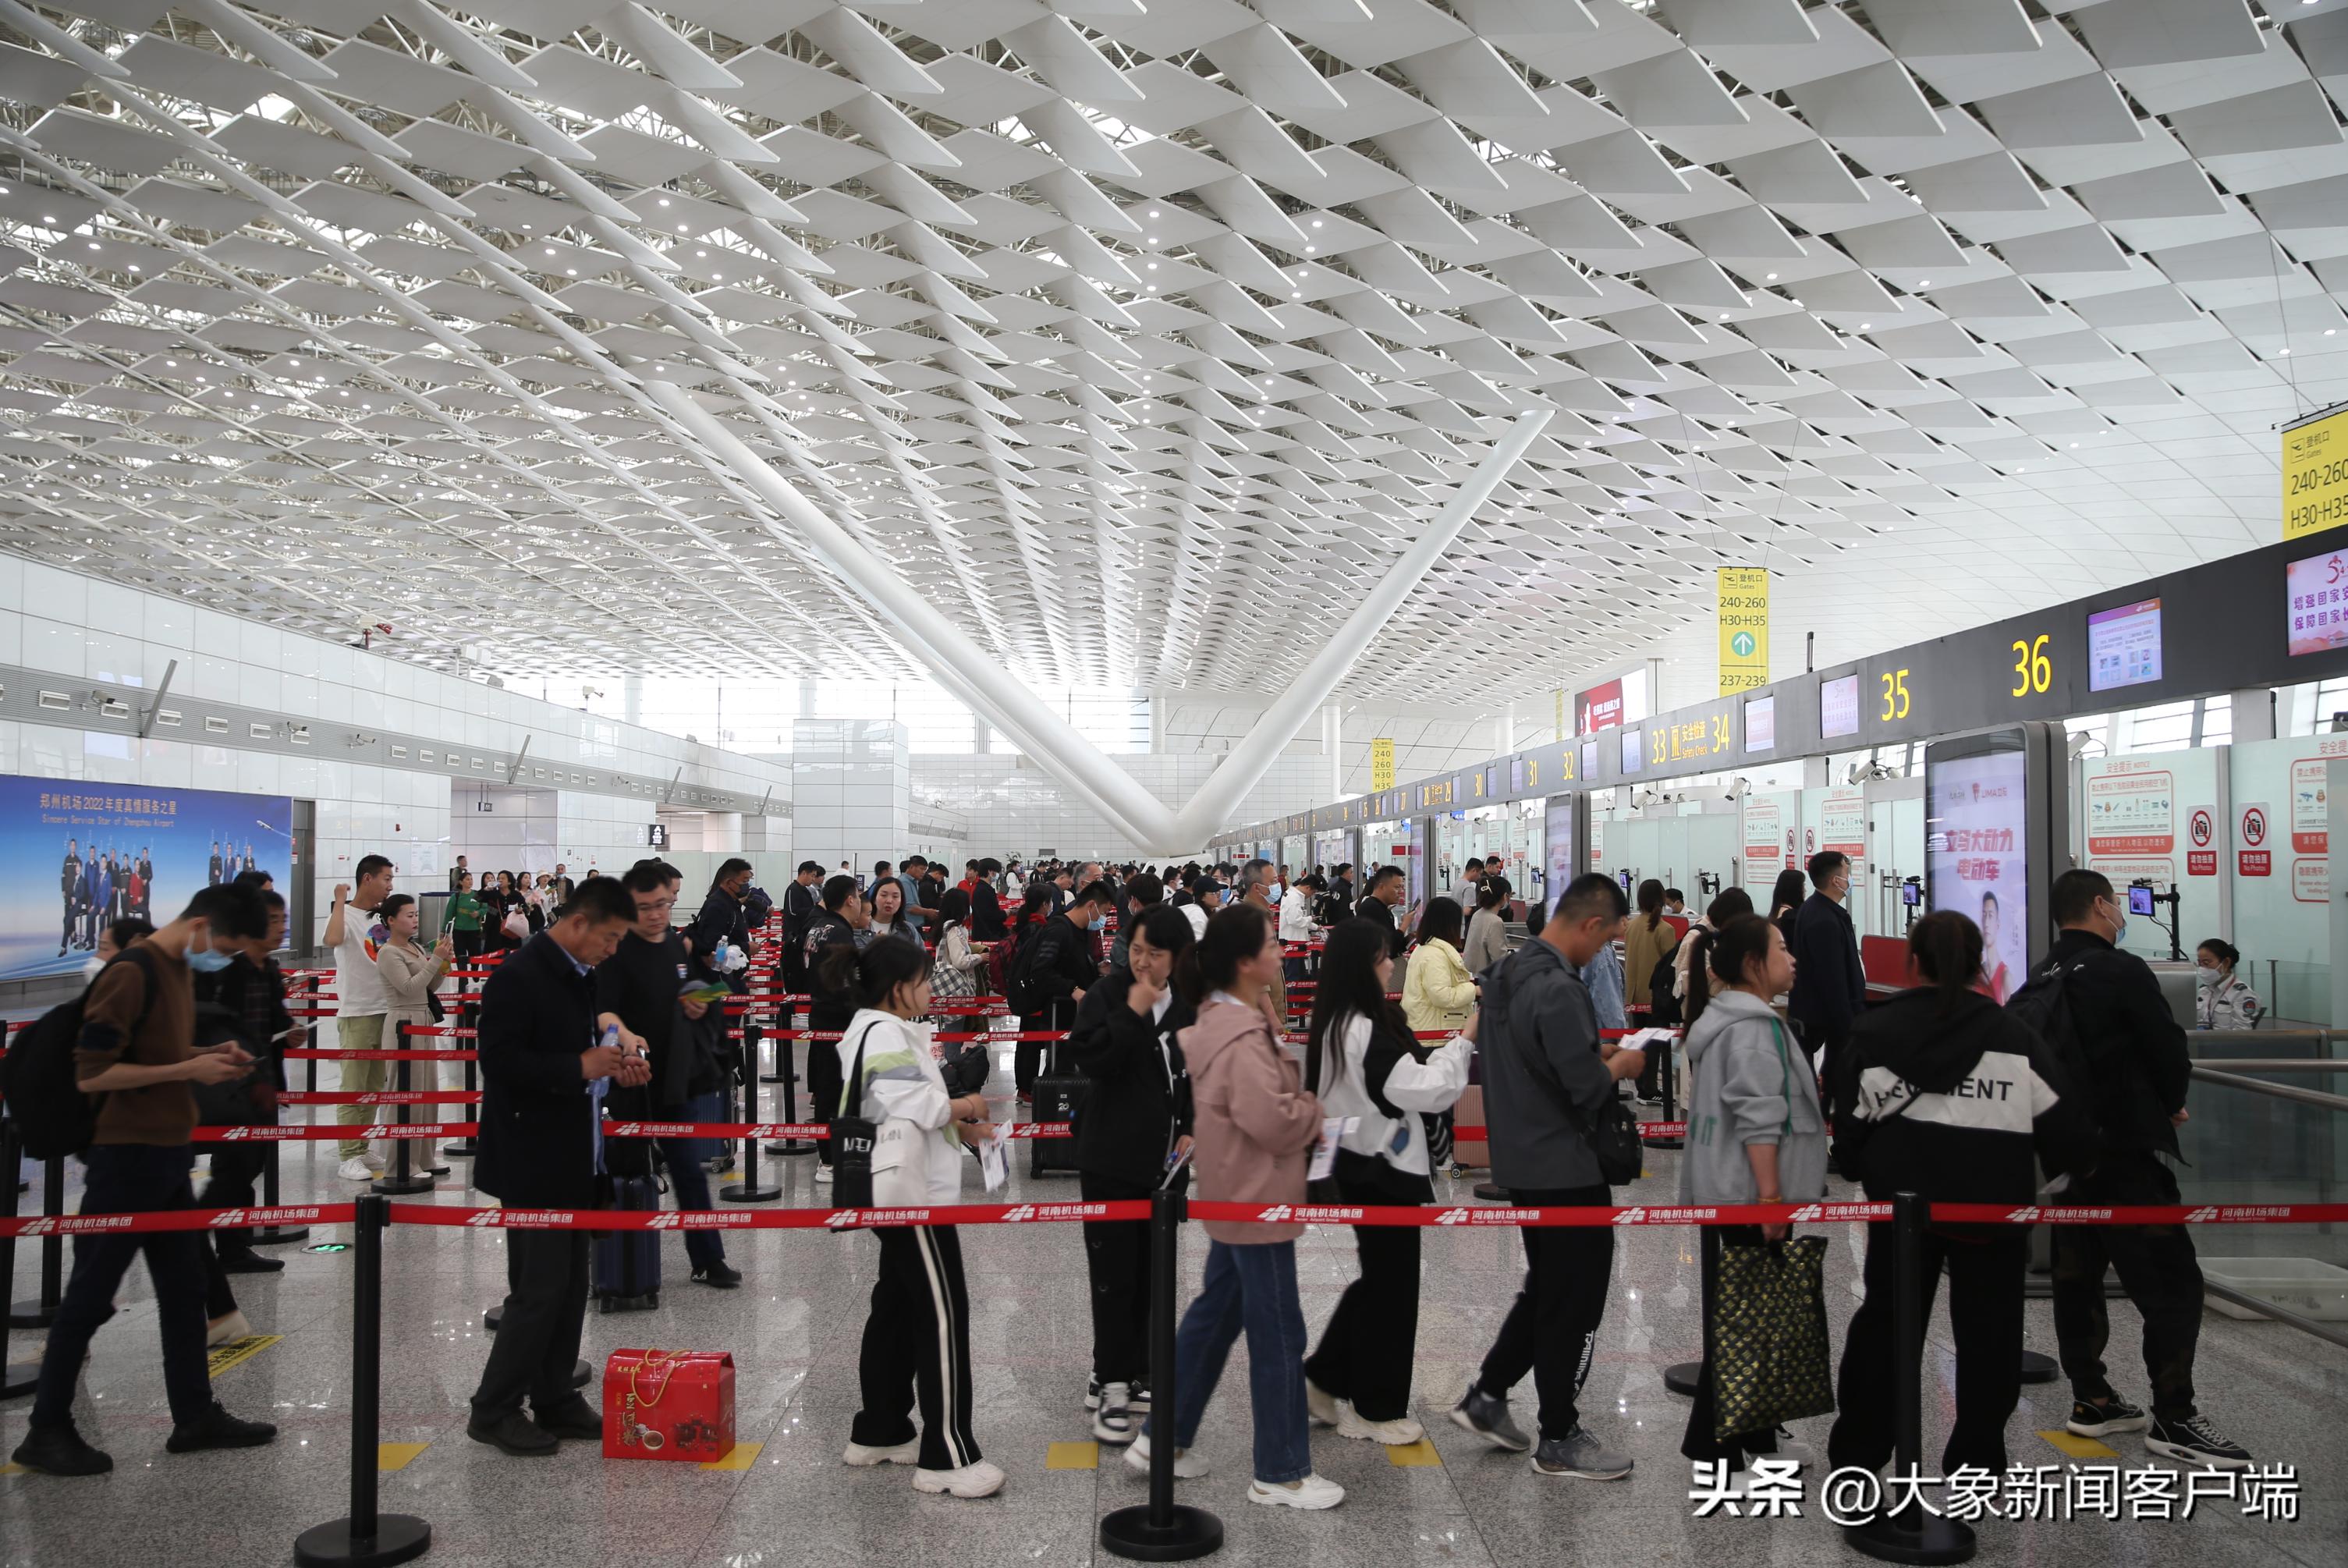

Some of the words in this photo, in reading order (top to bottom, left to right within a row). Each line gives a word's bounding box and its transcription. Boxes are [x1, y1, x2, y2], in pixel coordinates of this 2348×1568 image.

[2307, 431, 2330, 449] 登机口
[2307, 449, 2322, 459] Gates
[2013, 635, 2052, 697] 36
[1882, 669, 1910, 722] 35
[1682, 720, 1706, 742] 安全检查
[1712, 713, 1729, 753] 34
[1652, 729, 1666, 764] 33
[1563, 750, 1573, 780] 32
[1529, 760, 1538, 787] 31
[1475, 774, 1482, 796] 30
[1946, 828, 2013, 852] 立马大动力
[1957, 858, 2000, 881] 电动车
[251, 1127, 305, 1136] 河南机场集团
[390, 1126, 442, 1135] 河南机场集团
[775, 1126, 826, 1134] 河南机场集团
[249, 1208, 319, 1220] 河南机场集团
[861, 1210, 929, 1222] 河南机场集团
[1038, 1204, 1106, 1216] 河南机场集团
[1295, 1207, 1363, 1219] 河南机场集团
[1471, 1209, 1540, 1220] 河南机场集团
[1648, 1208, 1716, 1219] 河南机场集团
[1825, 1204, 1892, 1216] 河南机场集团
[2043, 1208, 2112, 1219] 河南机场集团
[2222, 1207, 2290, 1218] 河南机场集团
[59, 1216, 133, 1229] 河南机场集团
[505, 1212, 573, 1223] 河南机场集团
[684, 1213, 751, 1224] 河南机场集团
